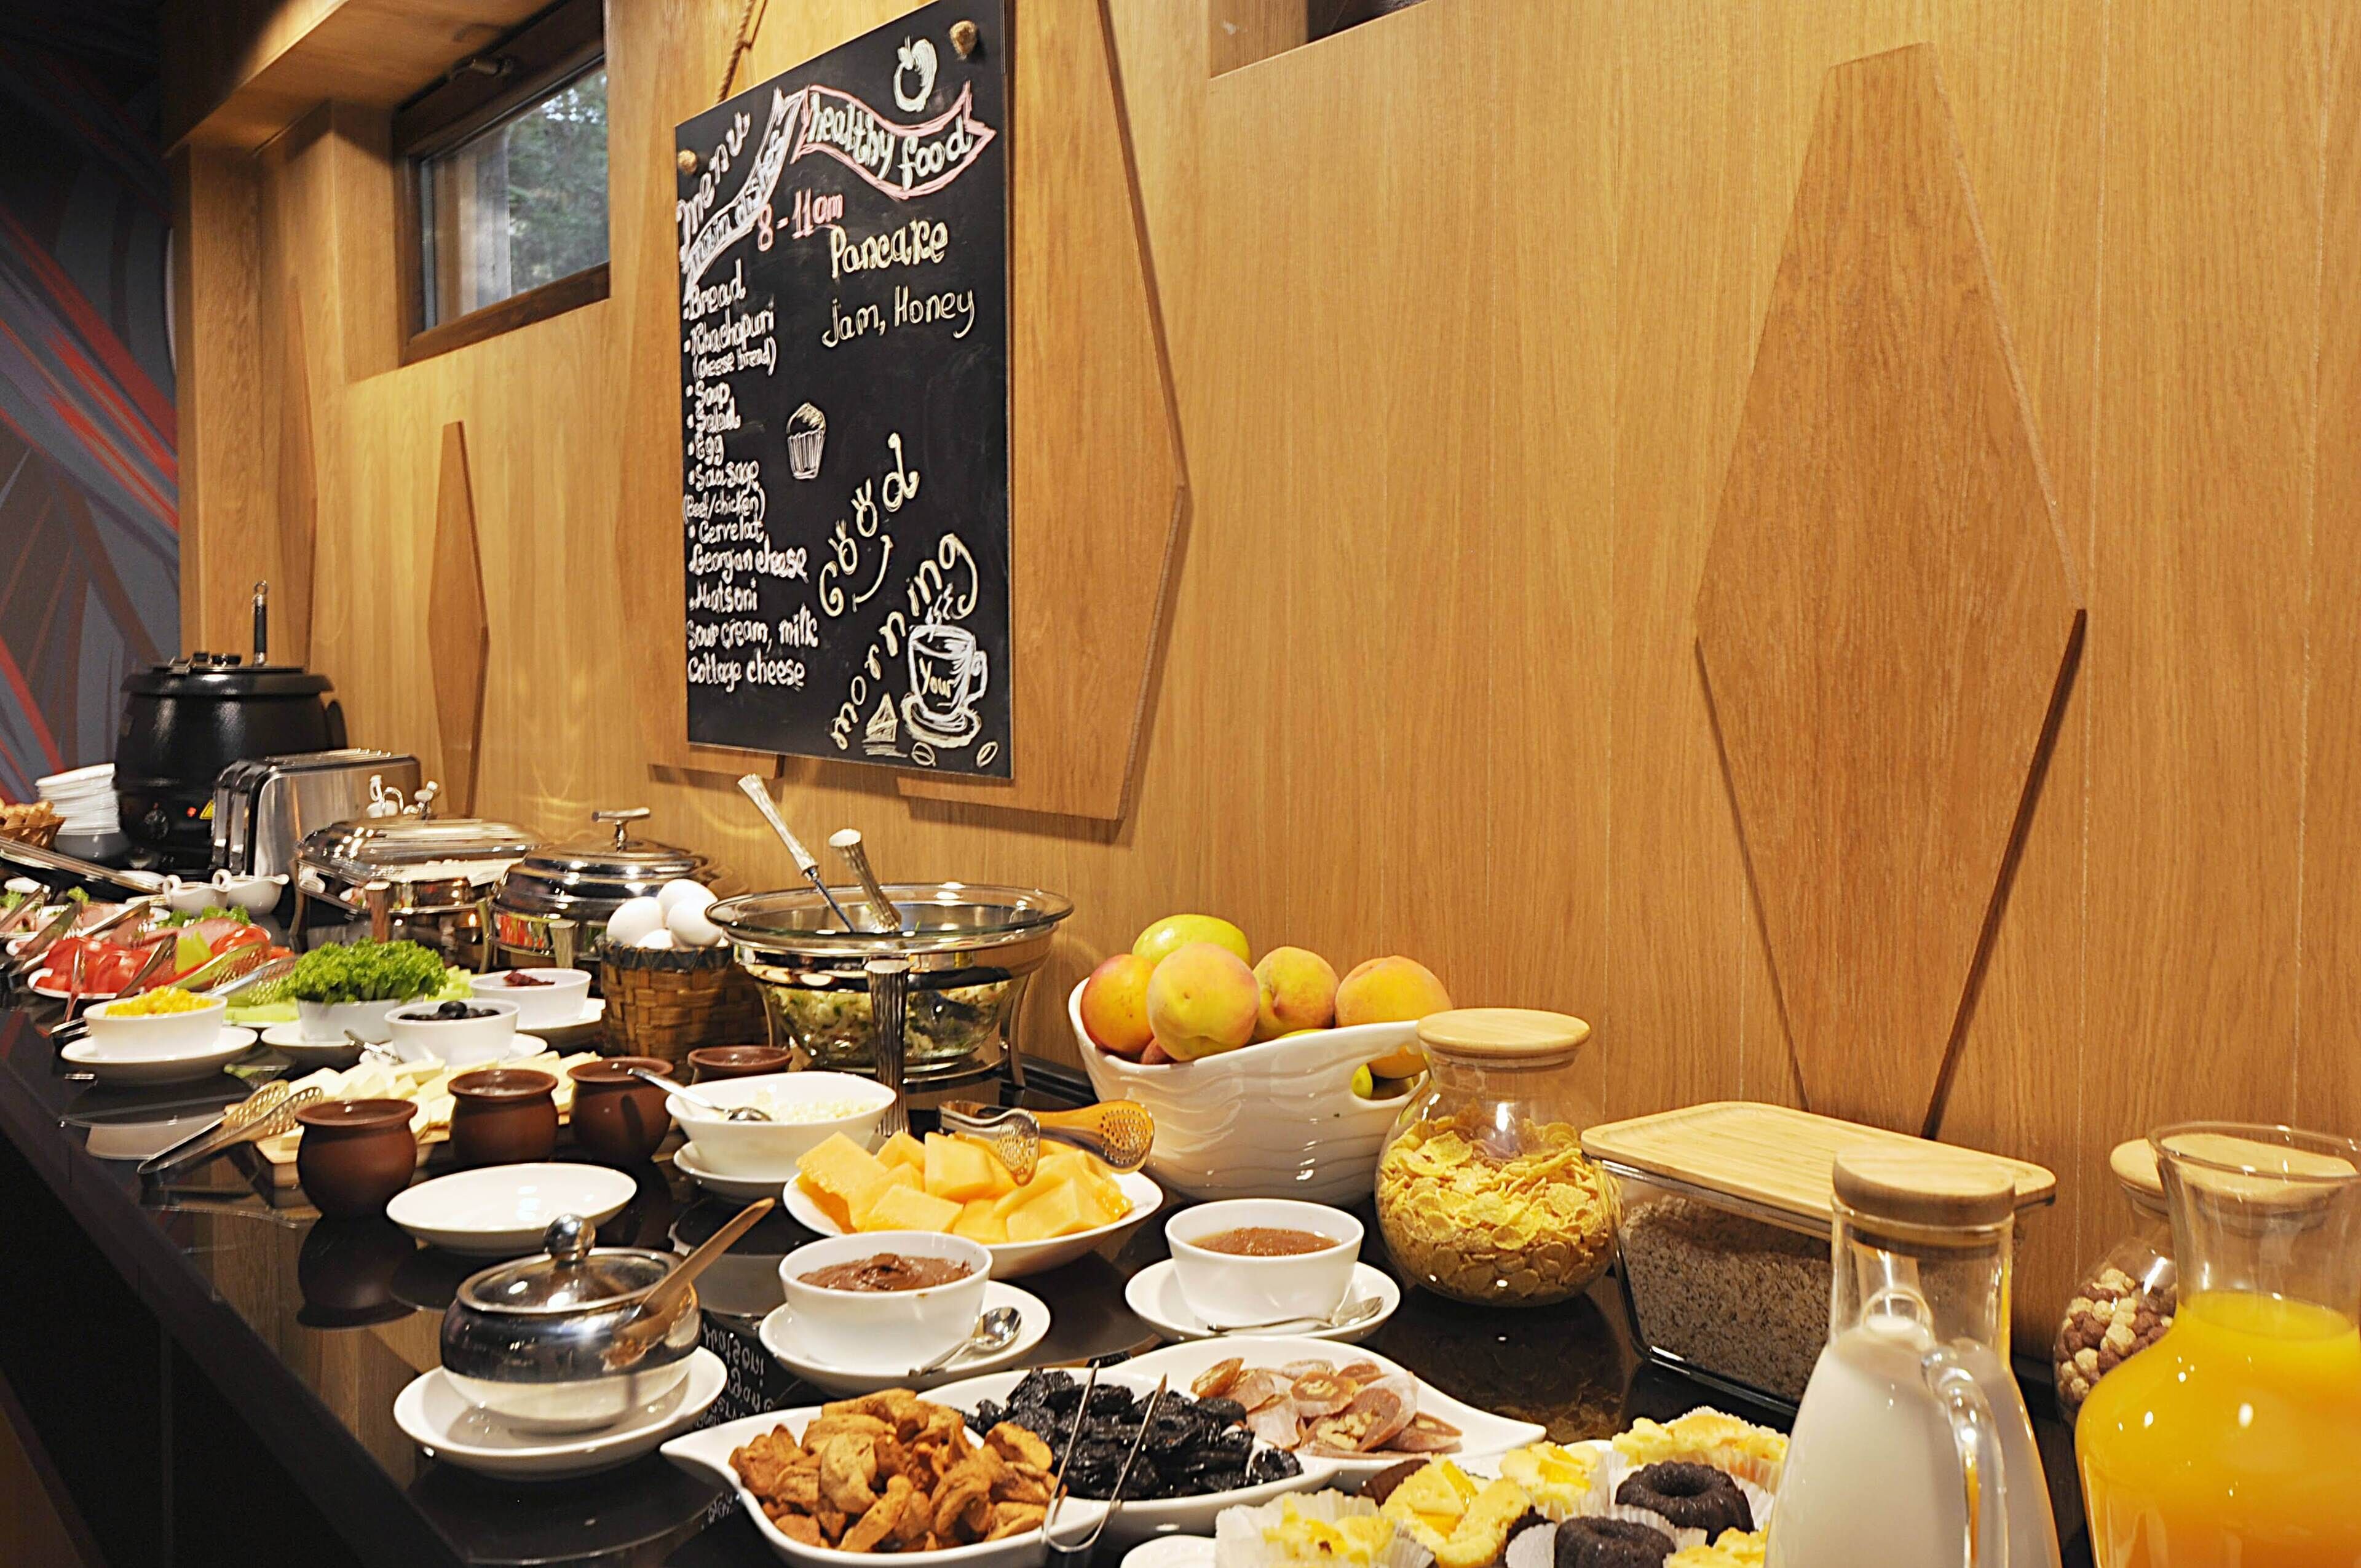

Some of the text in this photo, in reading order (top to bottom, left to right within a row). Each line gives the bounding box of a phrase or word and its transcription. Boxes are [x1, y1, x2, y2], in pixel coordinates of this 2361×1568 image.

[807, 92, 973, 191] healthy food
[831, 218, 949, 279] Pancake
[689, 258, 746, 321] Bread
[895, 285, 975, 339] Honey
[695, 397, 742, 434] Salad
[694, 430, 724, 466] Egg
[820, 432, 919, 617] Good
[687, 619, 720, 651] Sour
[778, 602, 819, 648] milk
[831, 533, 978, 750] morning
[746, 647, 805, 689] cheese
[919, 657, 955, 699] Your
